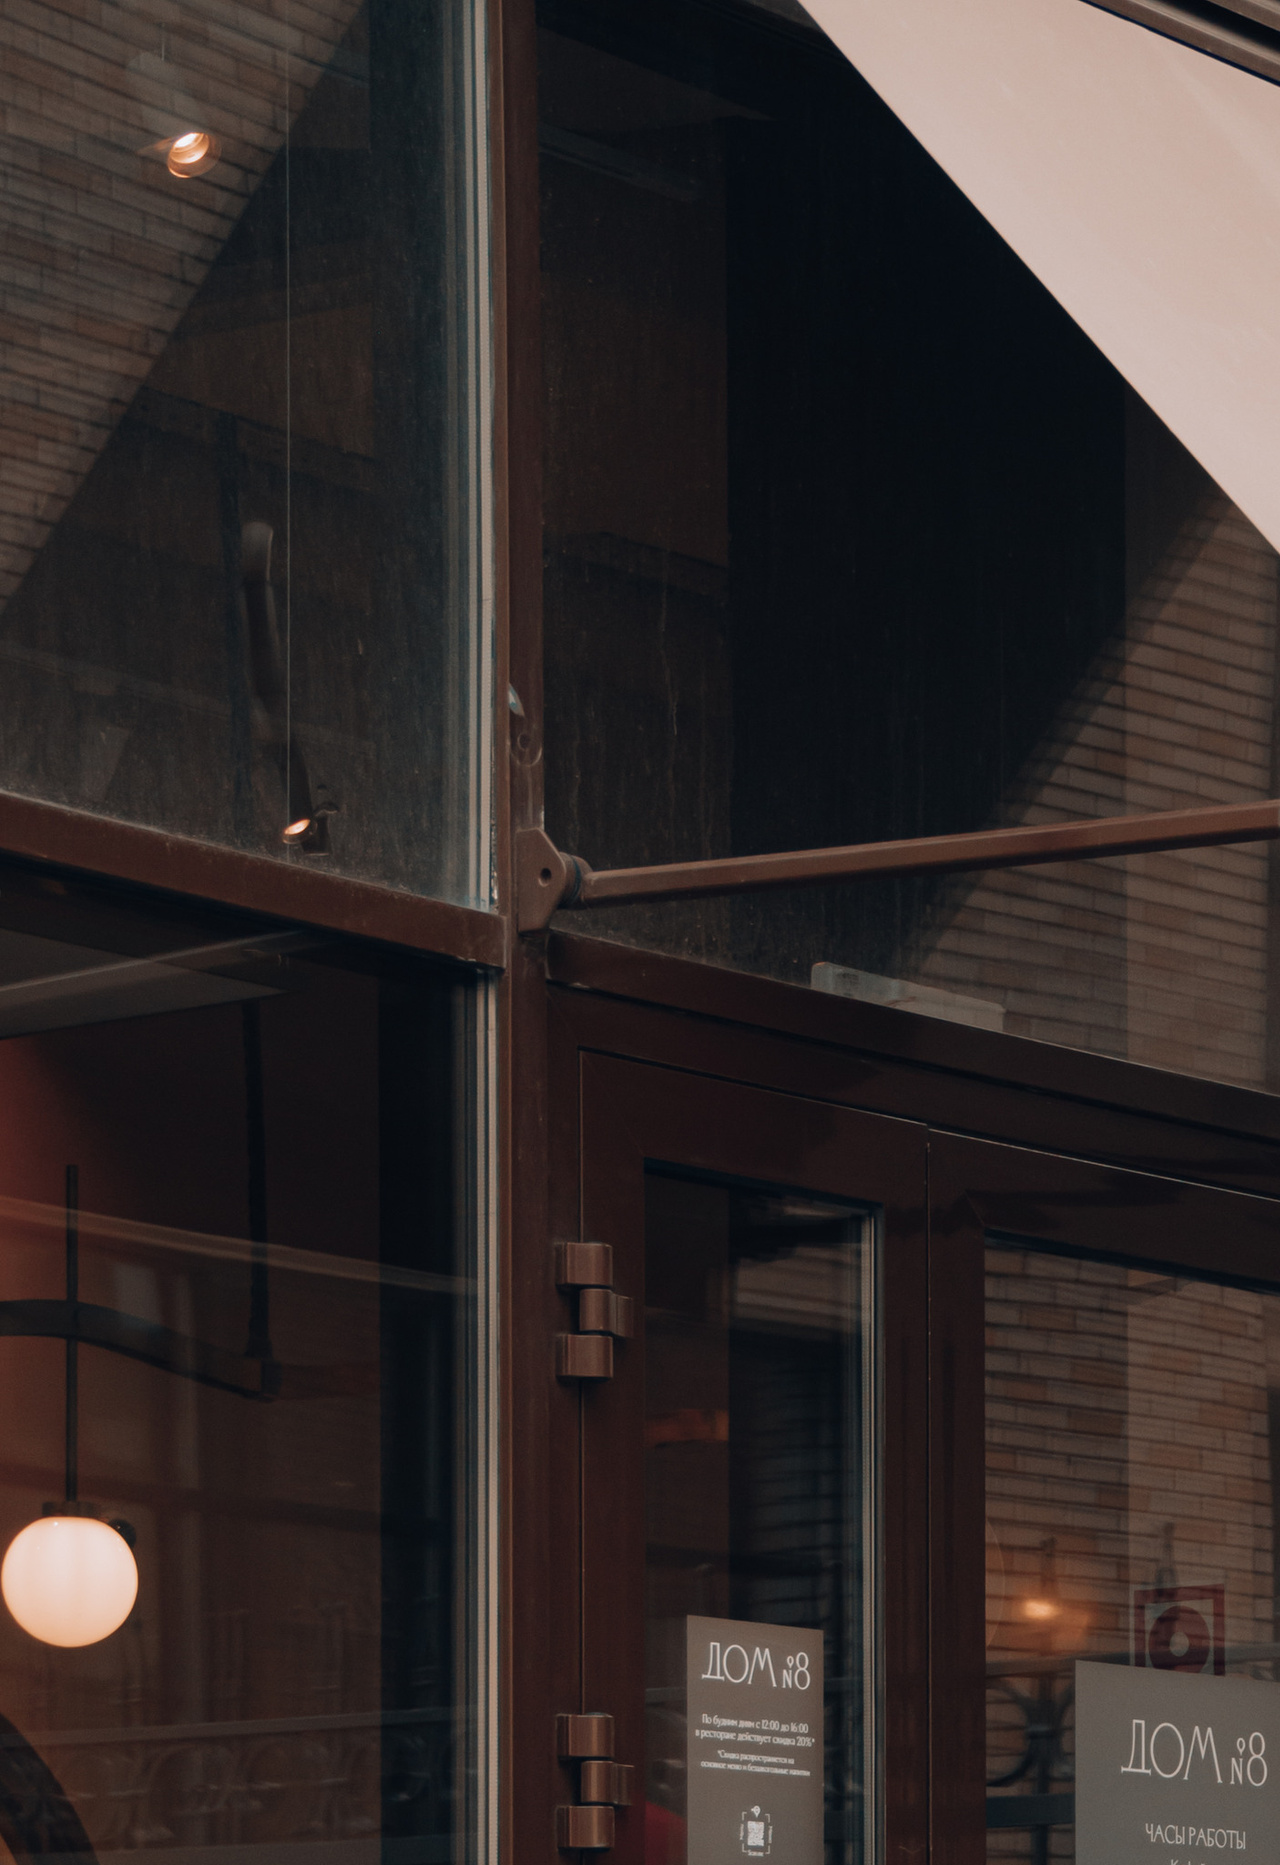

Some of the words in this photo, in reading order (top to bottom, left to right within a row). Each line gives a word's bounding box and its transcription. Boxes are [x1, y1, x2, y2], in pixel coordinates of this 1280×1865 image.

[702, 1642, 777, 1688] ДОМ
[702, 1713, 712, 1725] По
[761, 1719, 780, 1731] 12:00
[780, 1724, 790, 1732] до
[790, 1722, 809, 1734] 16:00
[700, 1729, 737, 1741] ресторане
[737, 1732, 772, 1745] действует
[772, 1737, 796, 1746] скидка
[1121, 1719, 1223, 1784] ДОМ
[1145, 1823, 1186, 1845] ЧАСЫ
[1188, 1826, 1246, 1849] РАБОТЫ
